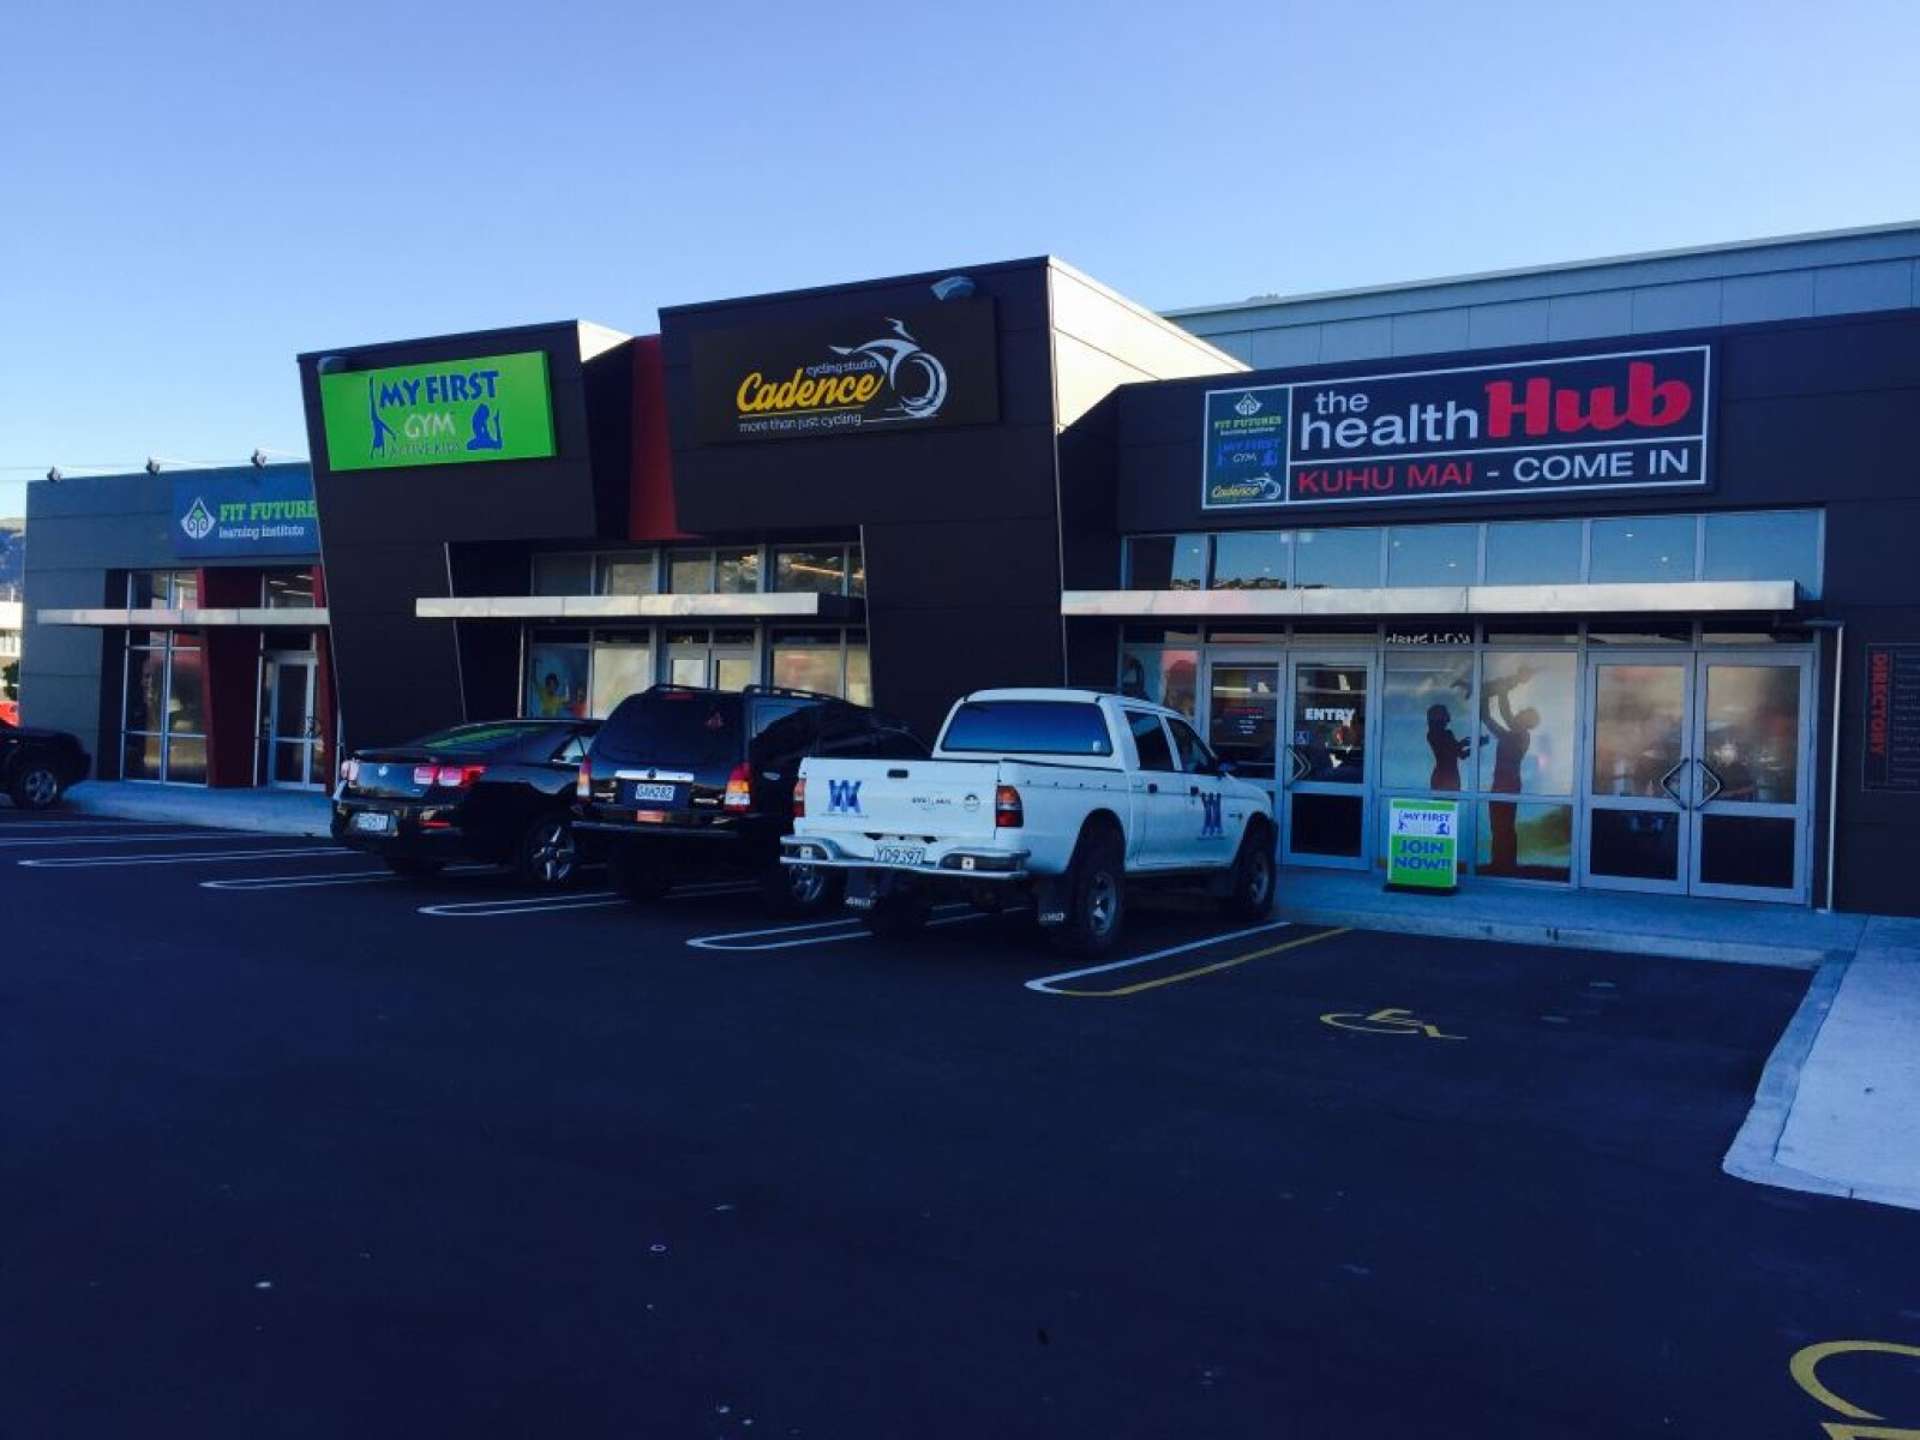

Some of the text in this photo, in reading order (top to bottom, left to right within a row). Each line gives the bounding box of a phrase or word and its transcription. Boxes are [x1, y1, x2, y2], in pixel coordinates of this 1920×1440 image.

[380, 370, 499, 409] MY FIRST
[736, 367, 885, 413] Cadence
[1301, 361, 1692, 451] health Hub
[1315, 391, 1370, 415] the
[404, 411, 456, 439] GYM
[739, 419, 768, 433] more
[769, 417, 797, 430] than
[820, 412, 862, 429] cycling
[1298, 465, 1395, 494] KUHU
[1407, 461, 1474, 489] MAI
[1513, 451, 1635, 483] COME
[1650, 447, 1689, 475] IN
[220, 503, 246, 521] FIT
[219, 525, 305, 540] learning institute
[1305, 707, 1355, 720] ENTRY
[1404, 812, 1450, 822] MY FIRST
[1401, 839, 1445, 854] JOIN
[1394, 856, 1451, 871] NOW!!
